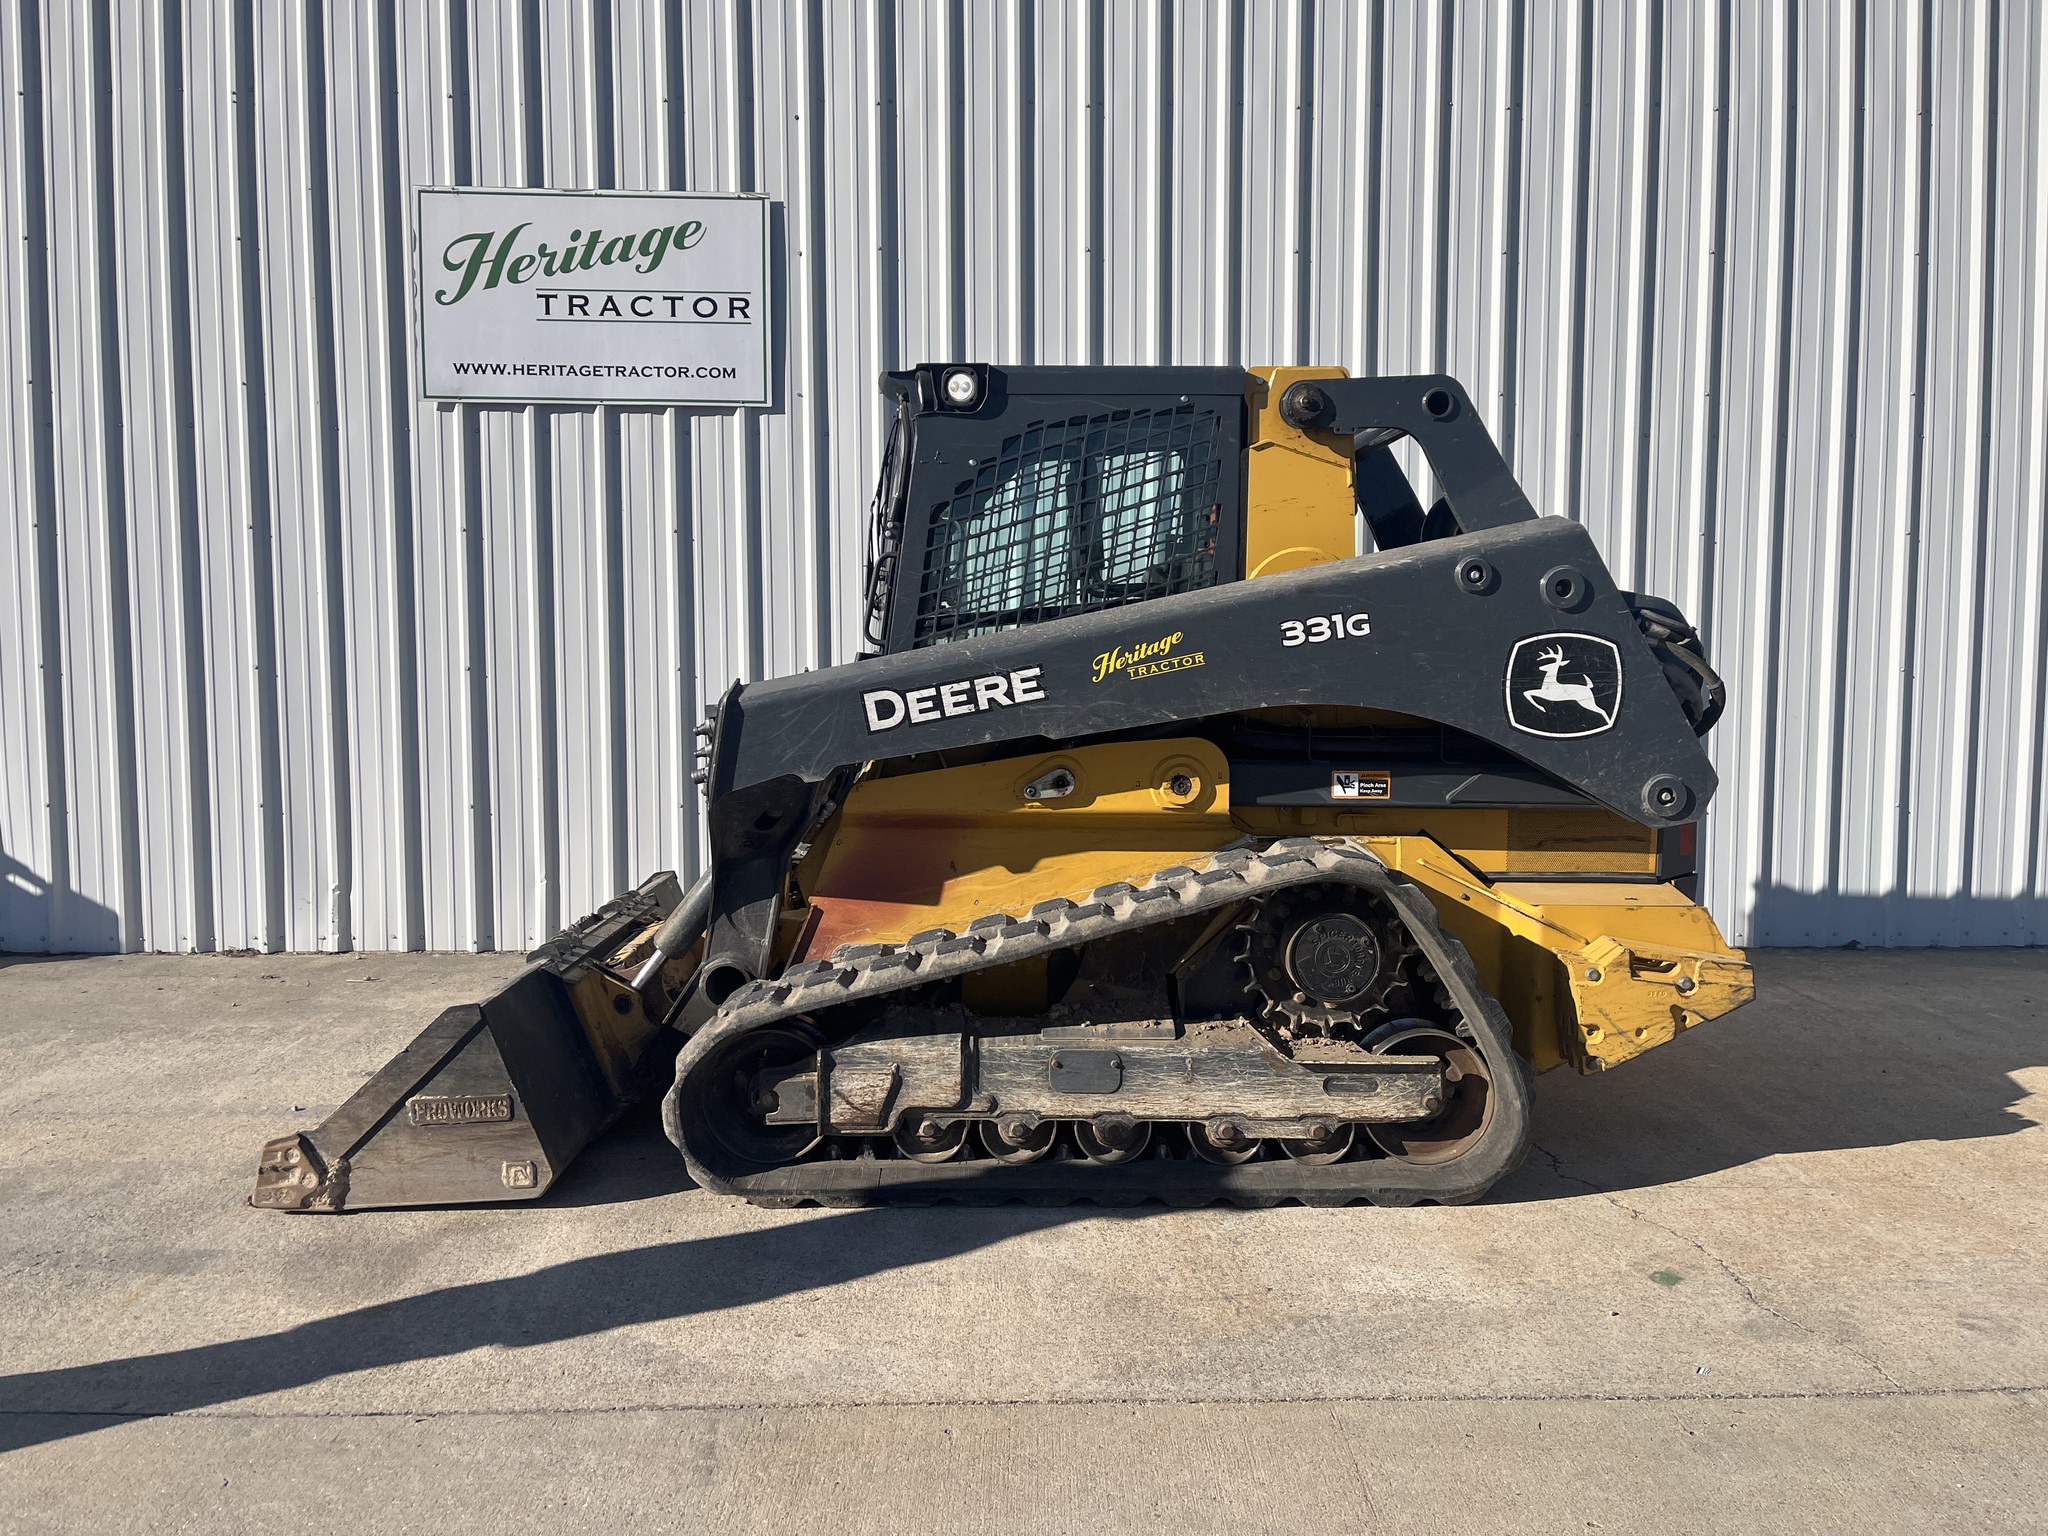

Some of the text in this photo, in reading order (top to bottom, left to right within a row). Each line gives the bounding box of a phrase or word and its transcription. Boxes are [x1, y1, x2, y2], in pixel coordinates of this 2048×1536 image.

[435, 220, 707, 306] Heritage
[536, 293, 752, 319] TRACTOR
[452, 362, 737, 379] WWW.HERITAGETRACTOR.COM
[1280, 612, 1372, 648] 331G
[1091, 630, 1184, 684] Heritage
[1127, 653, 1205, 678] TRACTOR
[862, 667, 1047, 734] DEERE
[413, 1100, 508, 1121] PROWORKS
